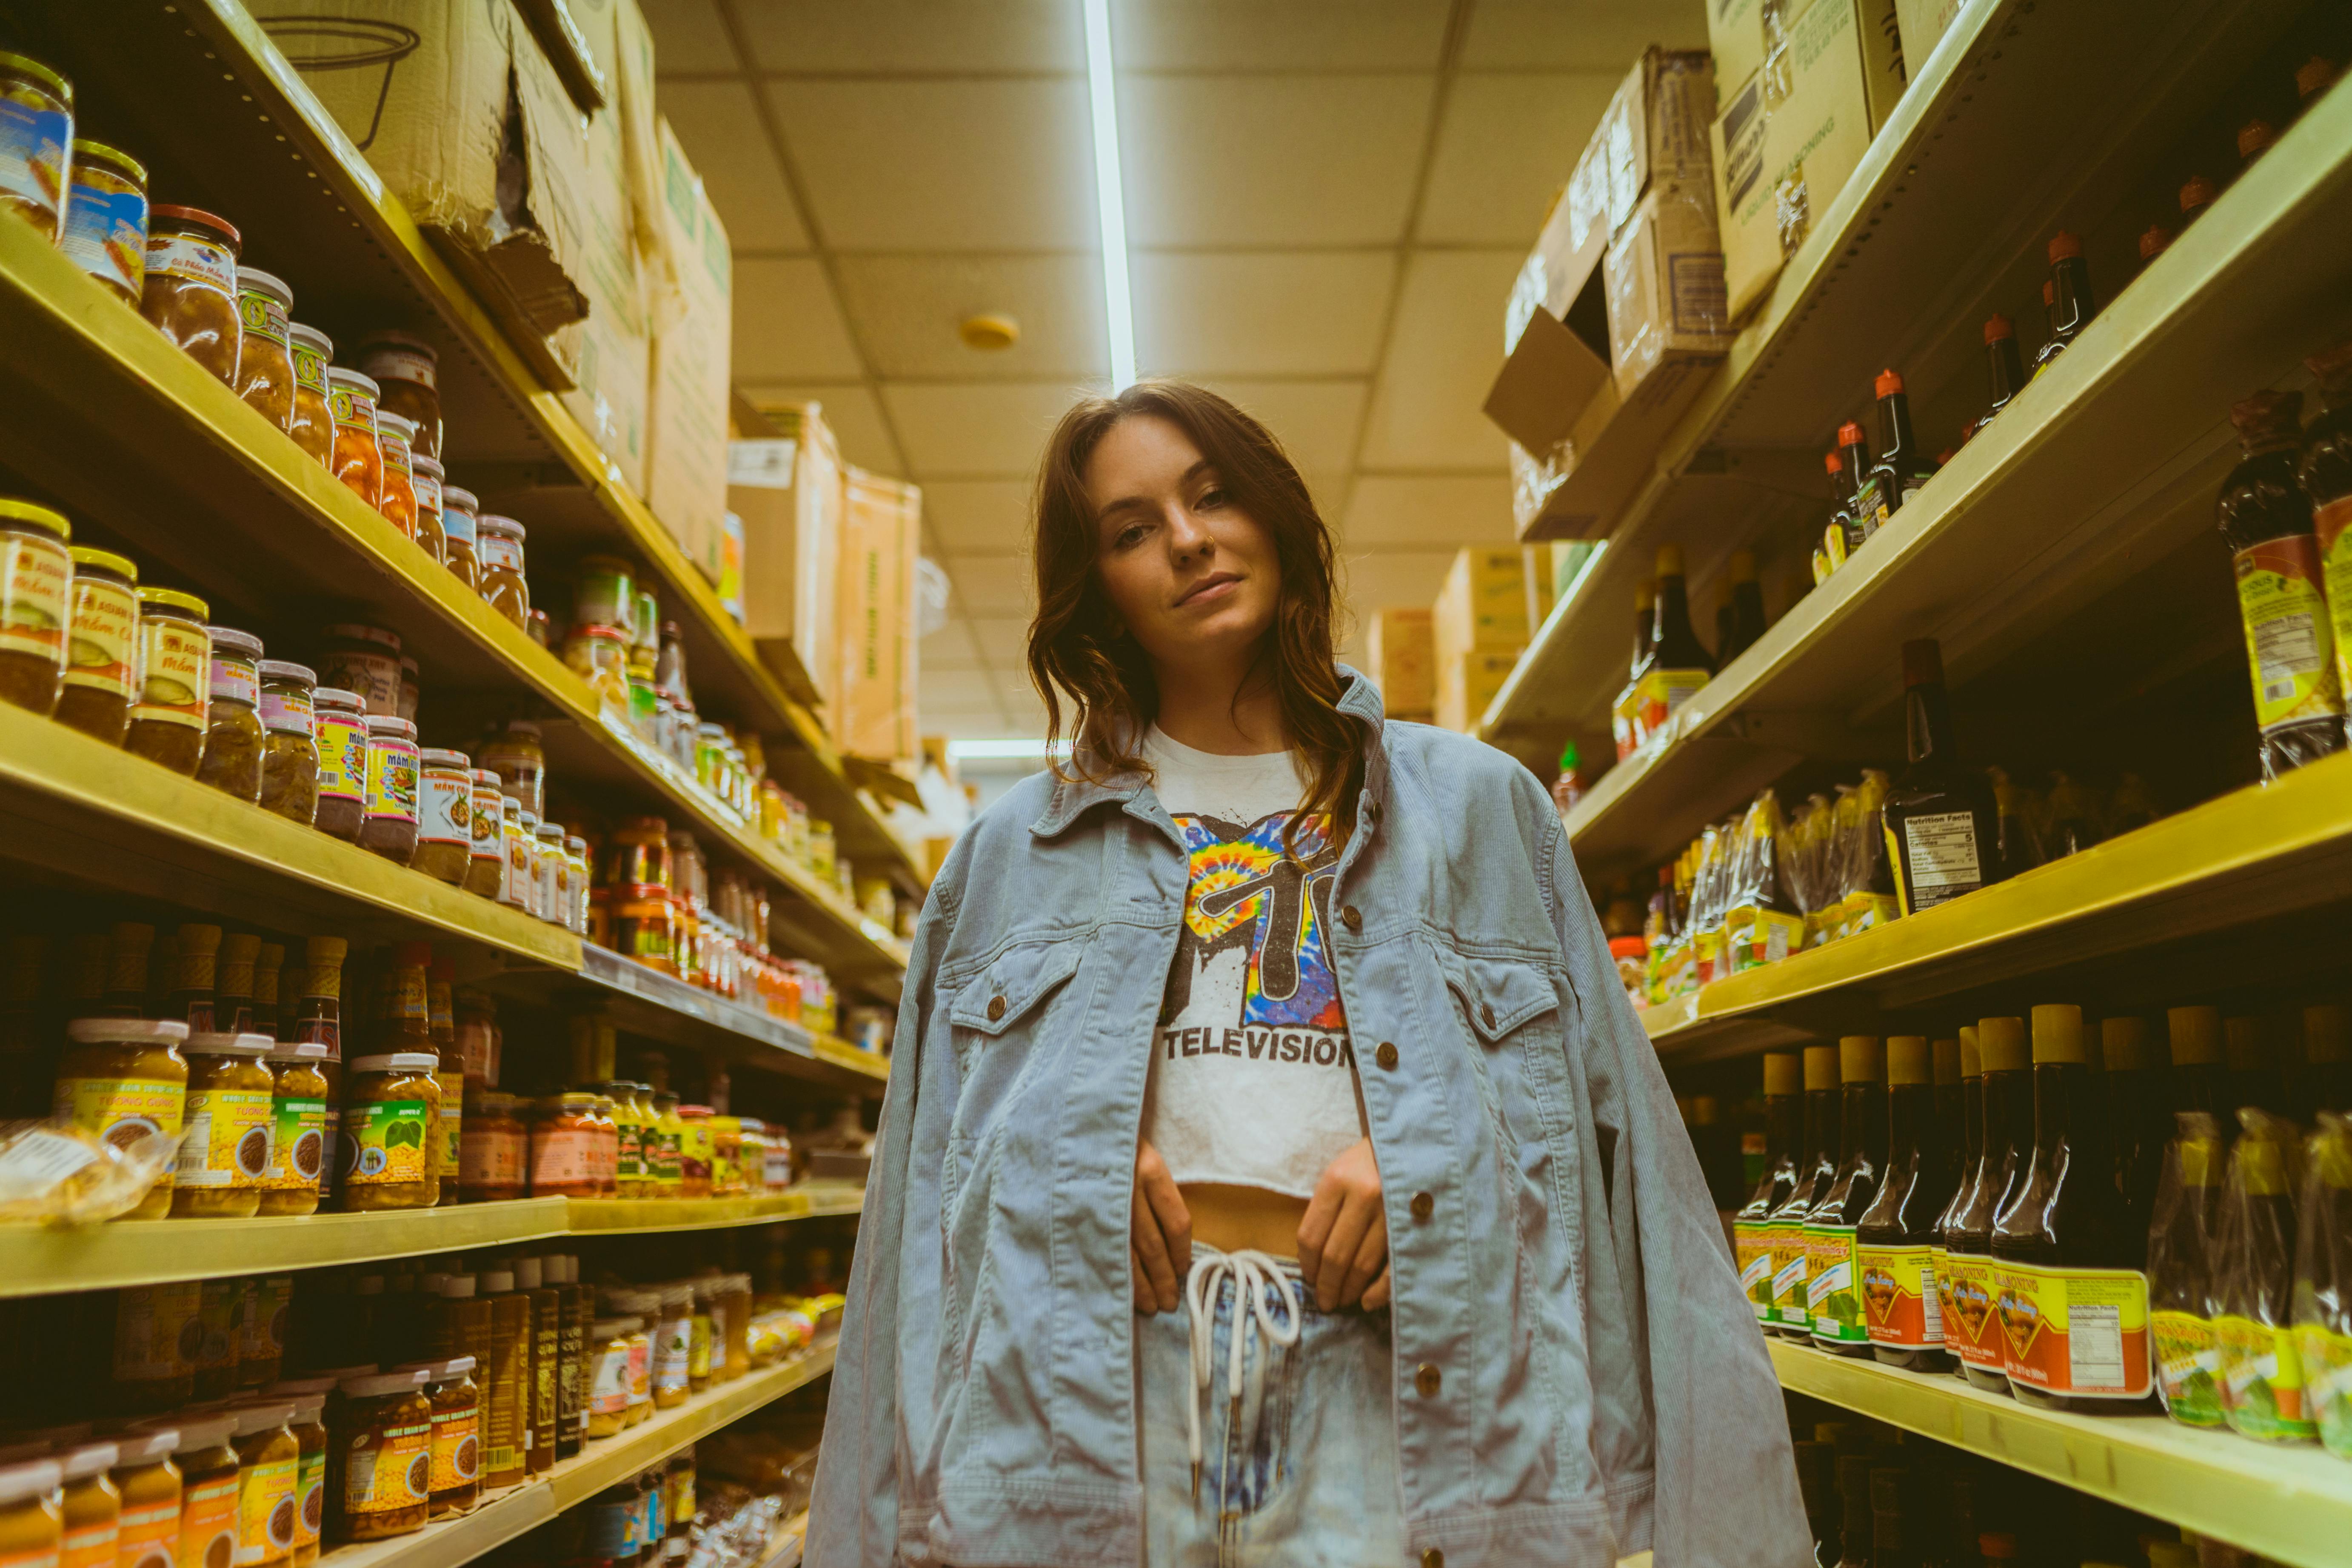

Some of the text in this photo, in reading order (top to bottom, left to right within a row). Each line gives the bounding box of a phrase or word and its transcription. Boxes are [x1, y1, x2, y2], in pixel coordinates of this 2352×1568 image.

[348, 731, 365, 746] MẮM
[387, 753, 409, 768] MẮM
[1907, 814, 1971, 826] Nutrition Facts
[1965, 834, 1972, 843] 5
[1163, 1027, 1357, 1069] TELEVISION
[1948, 1265, 1988, 1281] SEASONING
[1994, 1272, 2038, 1294] SEASONING
